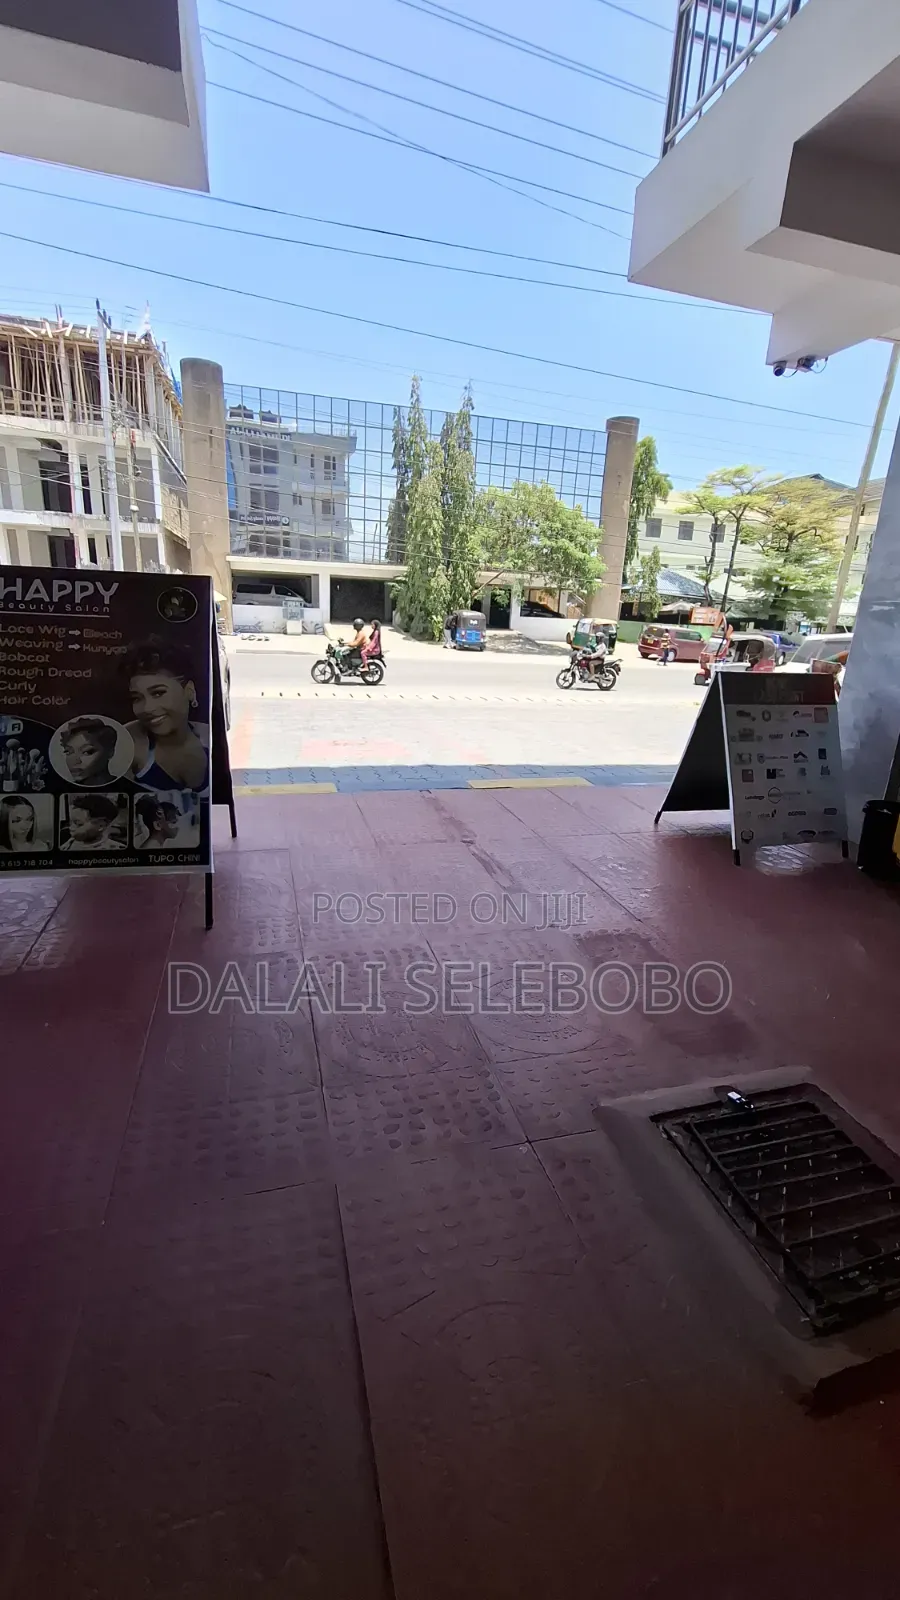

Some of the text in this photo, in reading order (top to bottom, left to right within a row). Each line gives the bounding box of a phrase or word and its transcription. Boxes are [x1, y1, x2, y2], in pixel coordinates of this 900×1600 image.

[0, 577, 119, 605] HAPPY
[65, 603, 110, 613] Salon
[0, 623, 34, 634] Lace
[38, 625, 67, 638] Wig
[0, 638, 64, 652] Weaving
[48, 668, 92, 678] Dread
[32, 695, 71, 706] Color
[148, 854, 175, 863] TUPO
